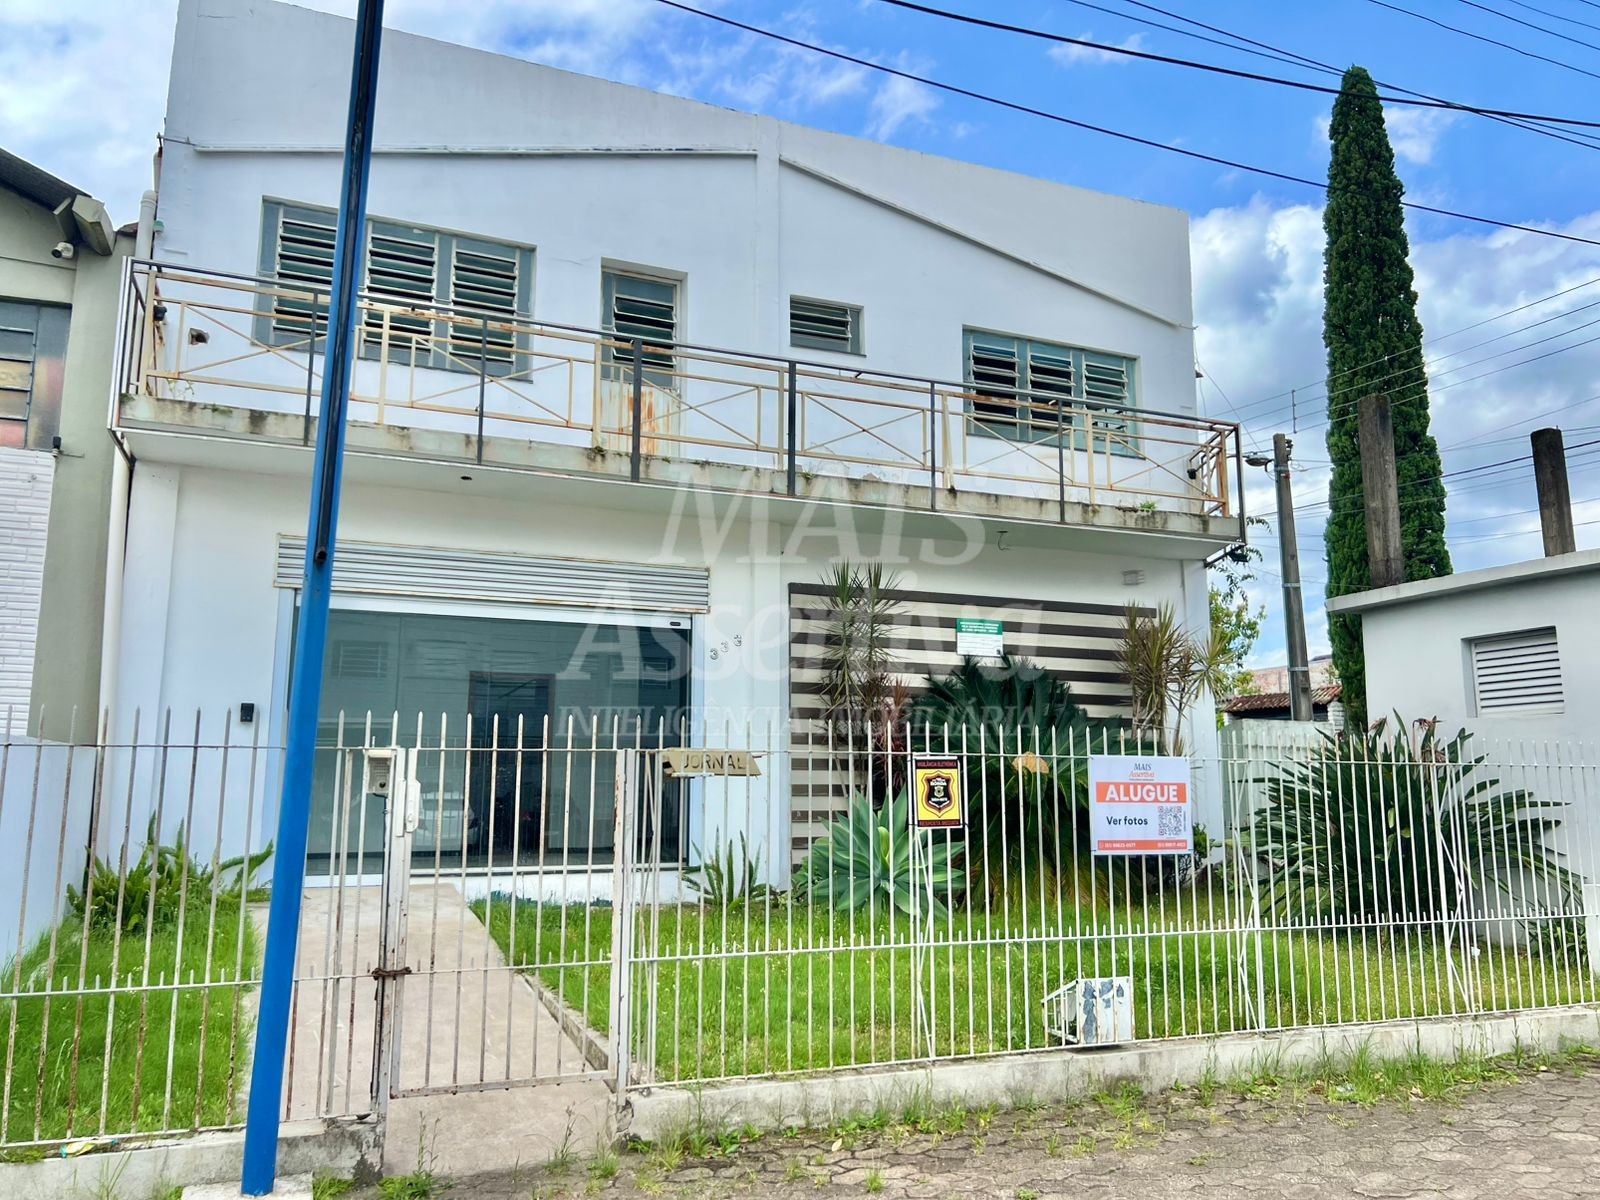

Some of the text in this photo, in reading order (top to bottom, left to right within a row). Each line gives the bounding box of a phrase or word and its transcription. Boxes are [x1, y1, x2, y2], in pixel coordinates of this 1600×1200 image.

[683, 754, 747, 769] JORNAL
[1134, 763, 1152, 771] MAIS
[1105, 784, 1178, 801] ALUGUE
[1106, 816, 1148, 825] Ver fotos
